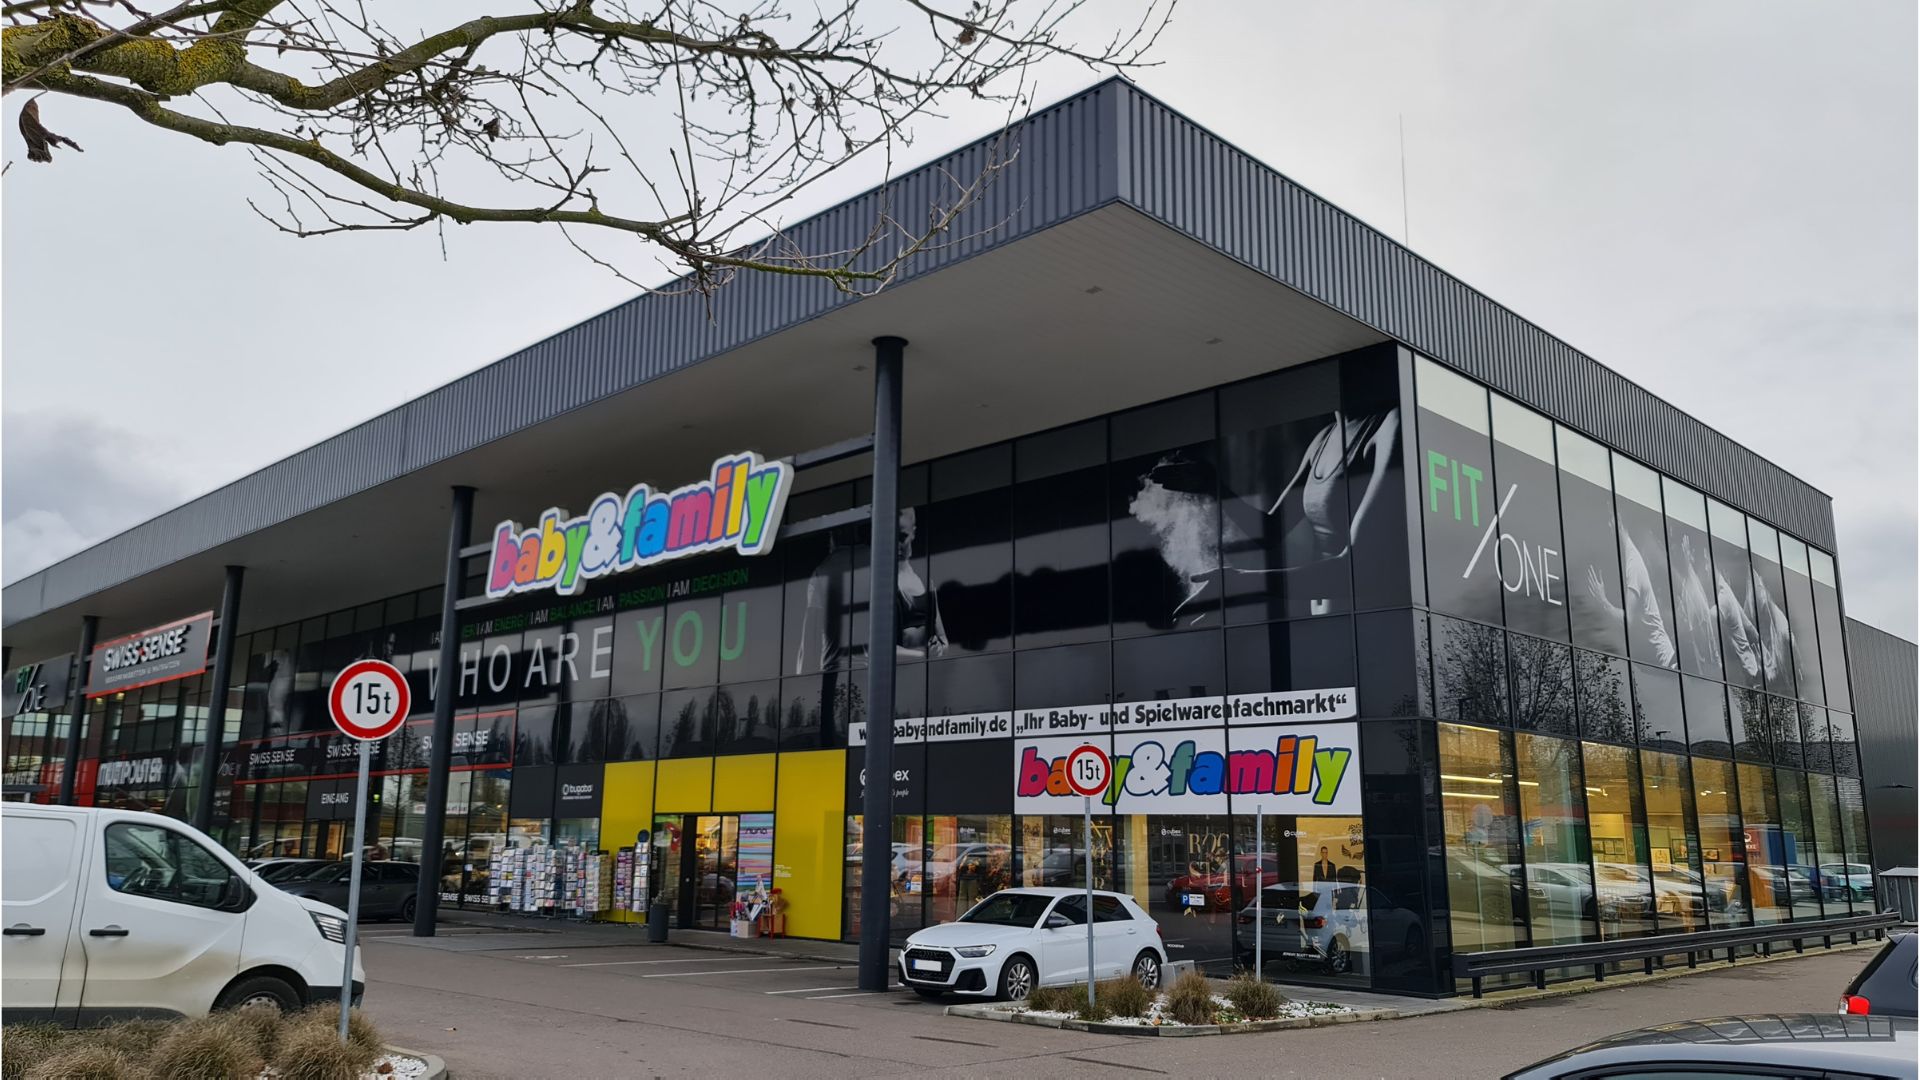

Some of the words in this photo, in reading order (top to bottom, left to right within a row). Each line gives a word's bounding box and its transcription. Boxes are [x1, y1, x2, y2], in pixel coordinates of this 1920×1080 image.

[1427, 449, 1484, 527] FIT
[488, 452, 785, 592] baby&family
[535, 609, 549, 624] AM
[550, 600, 595, 620] BALANCE
[672, 579, 690, 597] AM
[693, 568, 749, 593] DECISION
[1494, 533, 1562, 606] ONE
[140, 625, 186, 663] SENSE
[524, 624, 614, 688] ARE
[636, 602, 748, 672] YOU
[455, 730, 489, 747] SENSE
[1049, 710, 1094, 732] Baby-
[1100, 703, 1130, 727] und
[249, 752, 271, 765] SWISS
[271, 749, 295, 763] SENSE
[326, 743, 352, 758] SWISS
[353, 741, 381, 756] SSE
[1017, 734, 1352, 806] bay&family
